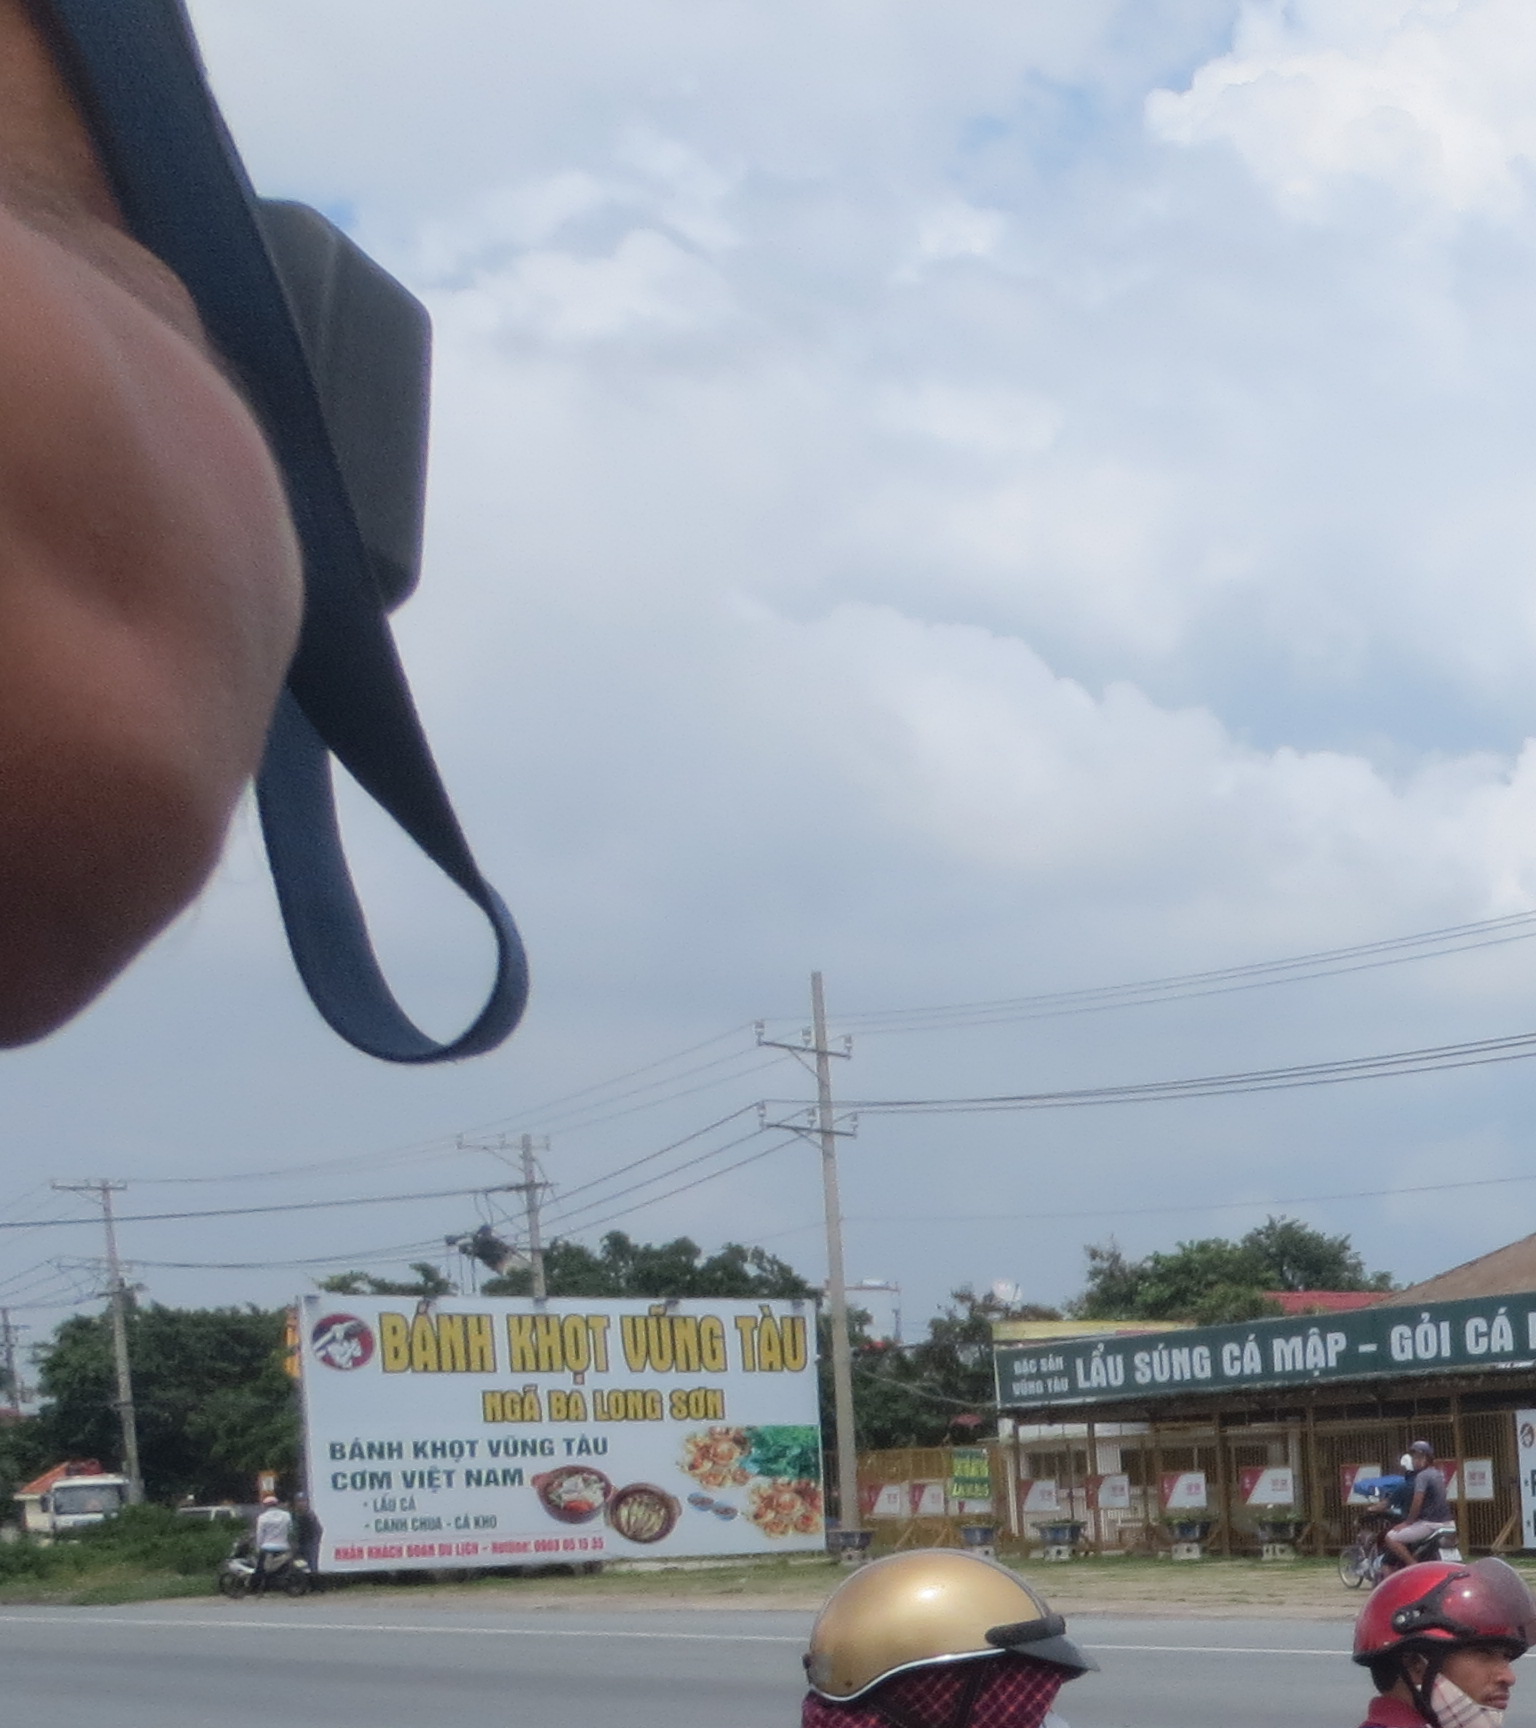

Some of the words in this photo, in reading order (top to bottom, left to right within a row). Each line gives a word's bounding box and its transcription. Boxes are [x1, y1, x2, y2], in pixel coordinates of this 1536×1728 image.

[379, 1300, 497, 1374] BÁNH
[506, 1314, 610, 1385] KHỌT
[620, 1304, 727, 1373] VŨNG
[736, 1304, 808, 1372] TÀU
[1075, 1343, 1125, 1389] LẨU
[1134, 1341, 1211, 1384] SÚNG
[1222, 1332, 1263, 1377] CÁ
[1272, 1327, 1348, 1377] MẬP
[1390, 1310, 1451, 1362] GỎI
[1465, 1304, 1514, 1357] CÁ
[1012, 1378, 1044, 1396] VŨNG
[1047, 1376, 1069, 1393] TÀU
[483, 1384, 542, 1423] NGÃ
[549, 1389, 587, 1422] BA
[595, 1388, 663, 1421] LONG
[670, 1387, 726, 1420] SƠN
[329, 1437, 403, 1461] BÁNH
[413, 1440, 479, 1463] KHỌT
[487, 1436, 555, 1459] VŨNG
[563, 1434, 608, 1457] TÀU
[331, 1469, 393, 1491] CƠM
[400, 1465, 456, 1493] VIỆT
[465, 1468, 524, 1488] NAM
[400, 1496, 416, 1512] CÁ
[375, 1517, 408, 1533] CANH
[411, 1516, 442, 1532] CHUA
[455, 1516, 471, 1531] CÁ
[473, 1515, 497, 1530] KHO
